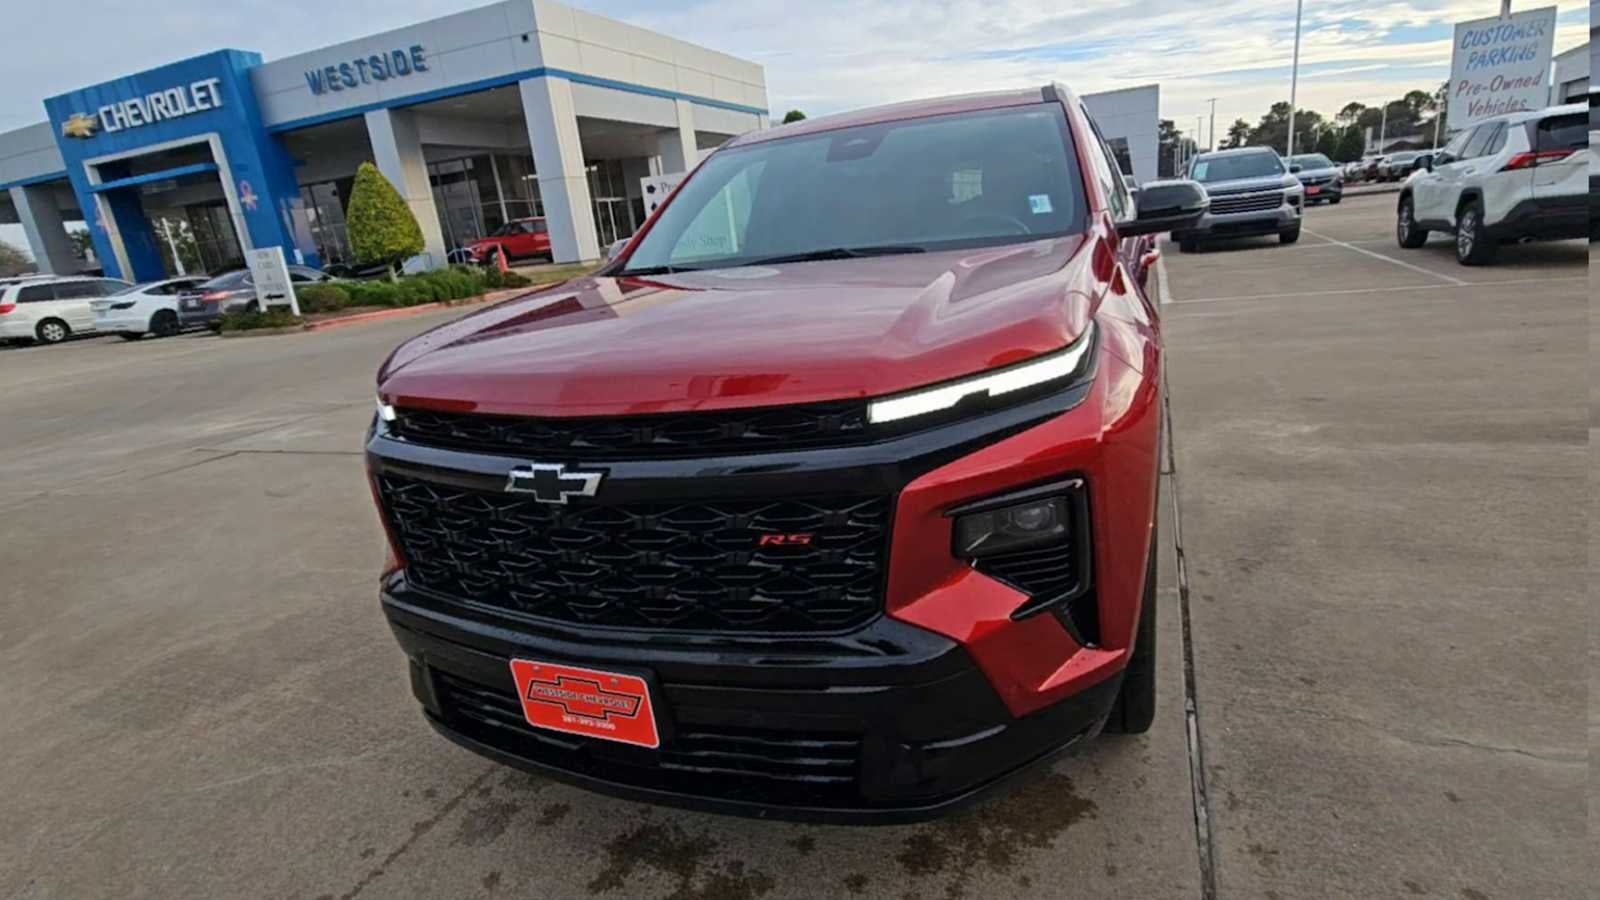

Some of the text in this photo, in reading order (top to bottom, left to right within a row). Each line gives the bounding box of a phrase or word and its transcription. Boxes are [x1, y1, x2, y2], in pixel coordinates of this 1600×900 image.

[1461, 19, 1547, 49] CUSTOMER
[1466, 42, 1537, 70] PARKING
[304, 45, 429, 96] WESTSIDE
[1456, 71, 1544, 98] Pre-Owned
[98, 77, 222, 133] CHEVROLET
[1468, 96, 1529, 117] Vehicles
[759, 534, 811, 545] RS
